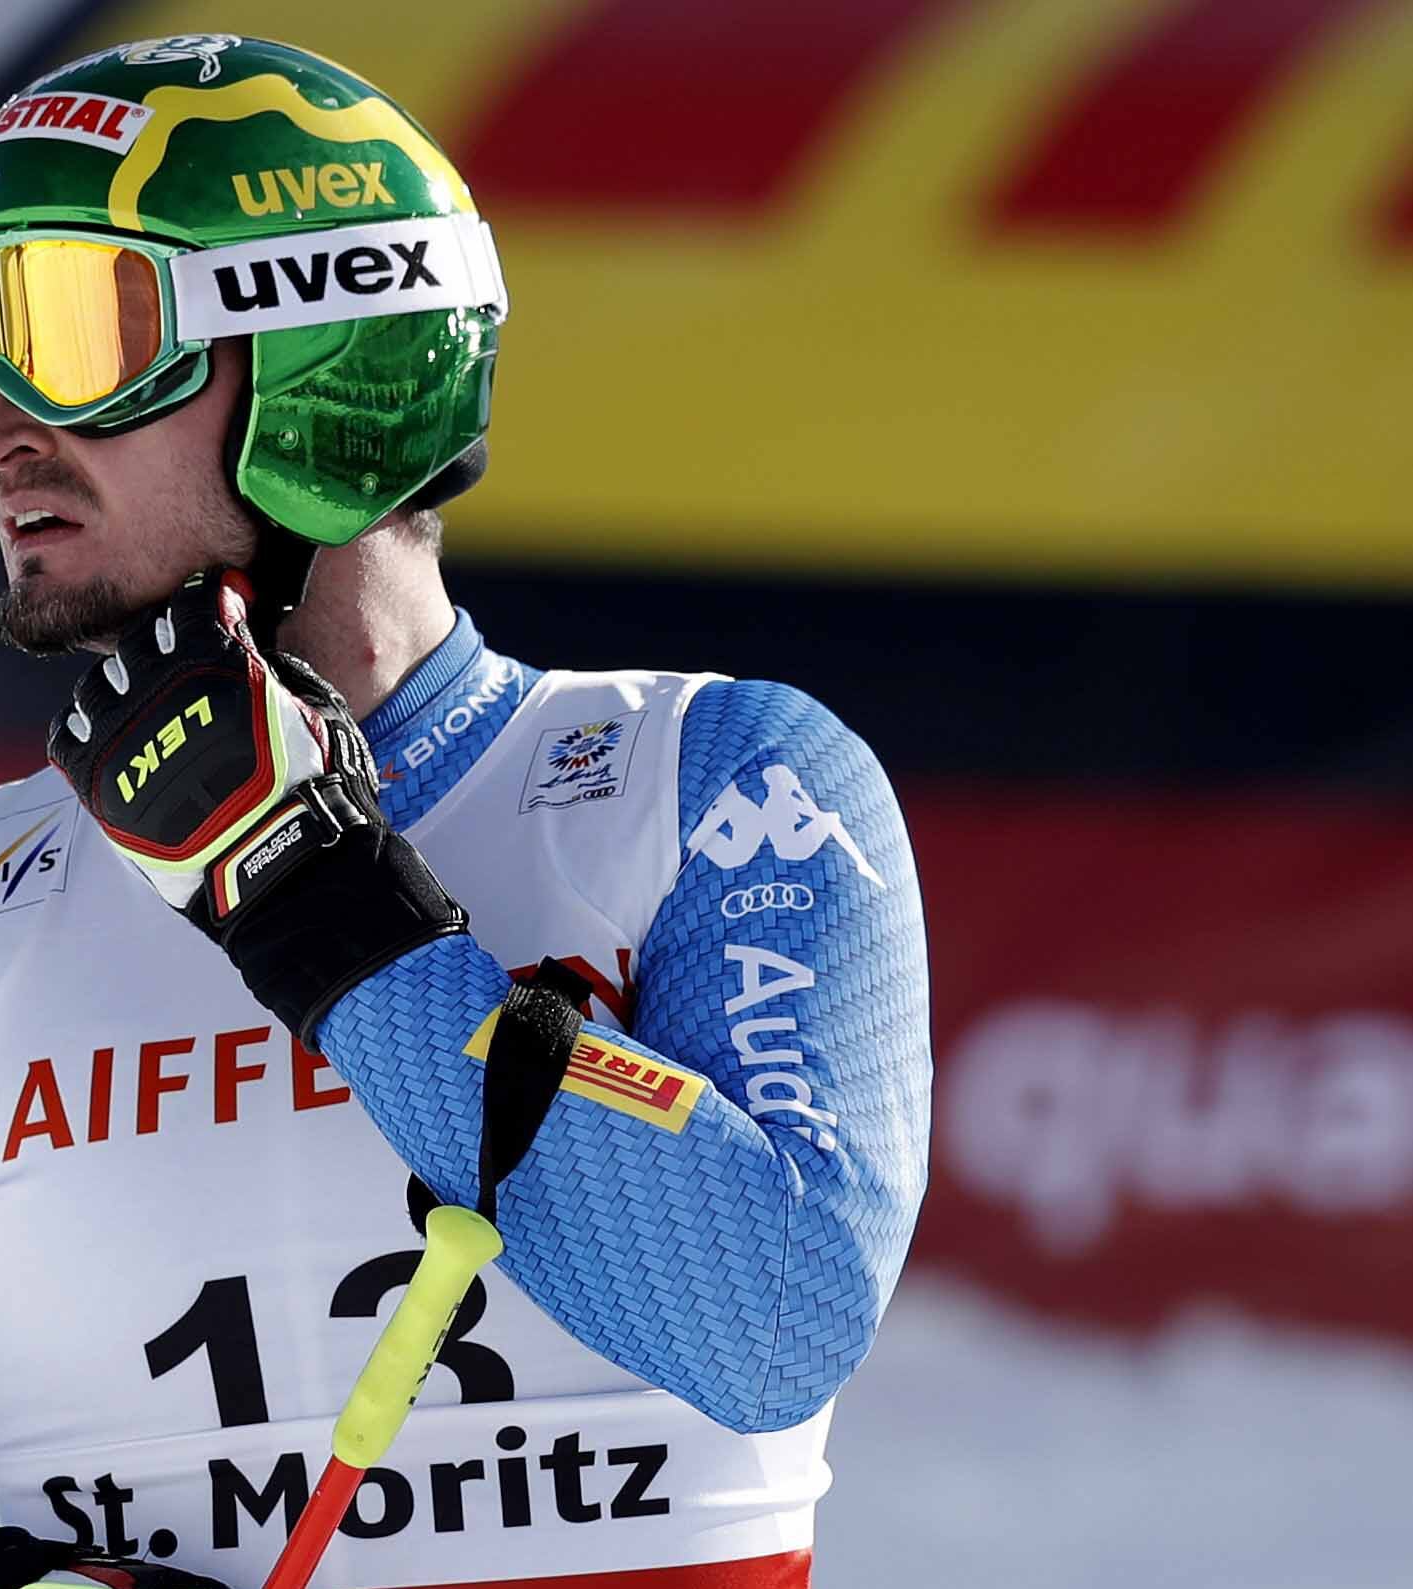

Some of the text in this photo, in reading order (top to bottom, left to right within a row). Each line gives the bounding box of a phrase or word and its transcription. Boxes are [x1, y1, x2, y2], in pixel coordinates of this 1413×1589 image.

[231, 161, 396, 217] uvex
[214, 240, 442, 313] uvex
[116, 695, 213, 804] LEKI
[247, 829, 302, 879] RACING
[564, 1043, 685, 1113] PIRE
[724, 943, 838, 1151] Audi
[144, 1249, 515, 1429] 13
[42, 1425, 671, 1558] St. Moritz
